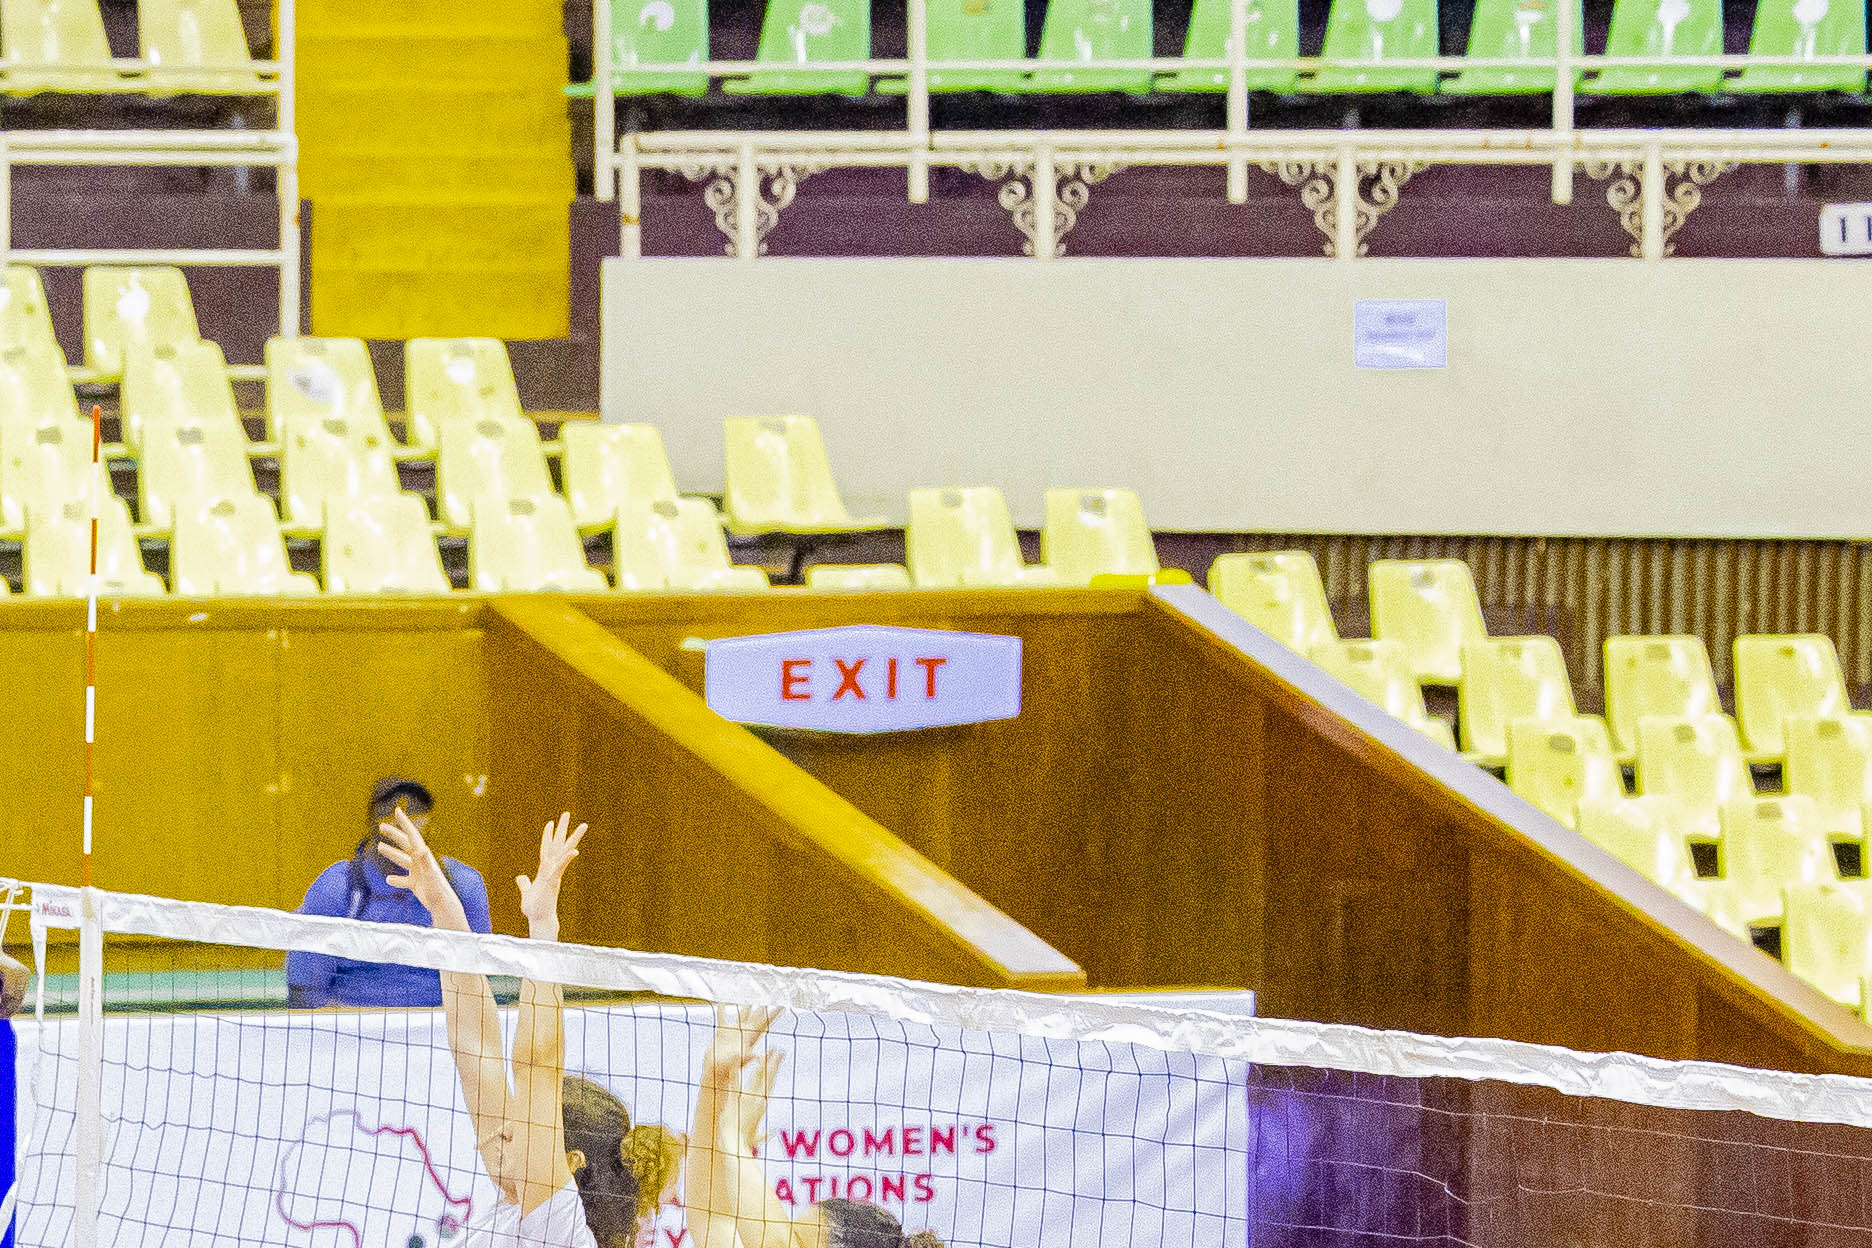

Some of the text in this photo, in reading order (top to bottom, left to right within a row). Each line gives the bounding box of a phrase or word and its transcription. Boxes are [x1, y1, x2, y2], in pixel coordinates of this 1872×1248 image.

[779, 657, 947, 701] EXIT
[778, 1124, 996, 1158] WOMEN'S
[775, 1173, 935, 1206] ATIONS
